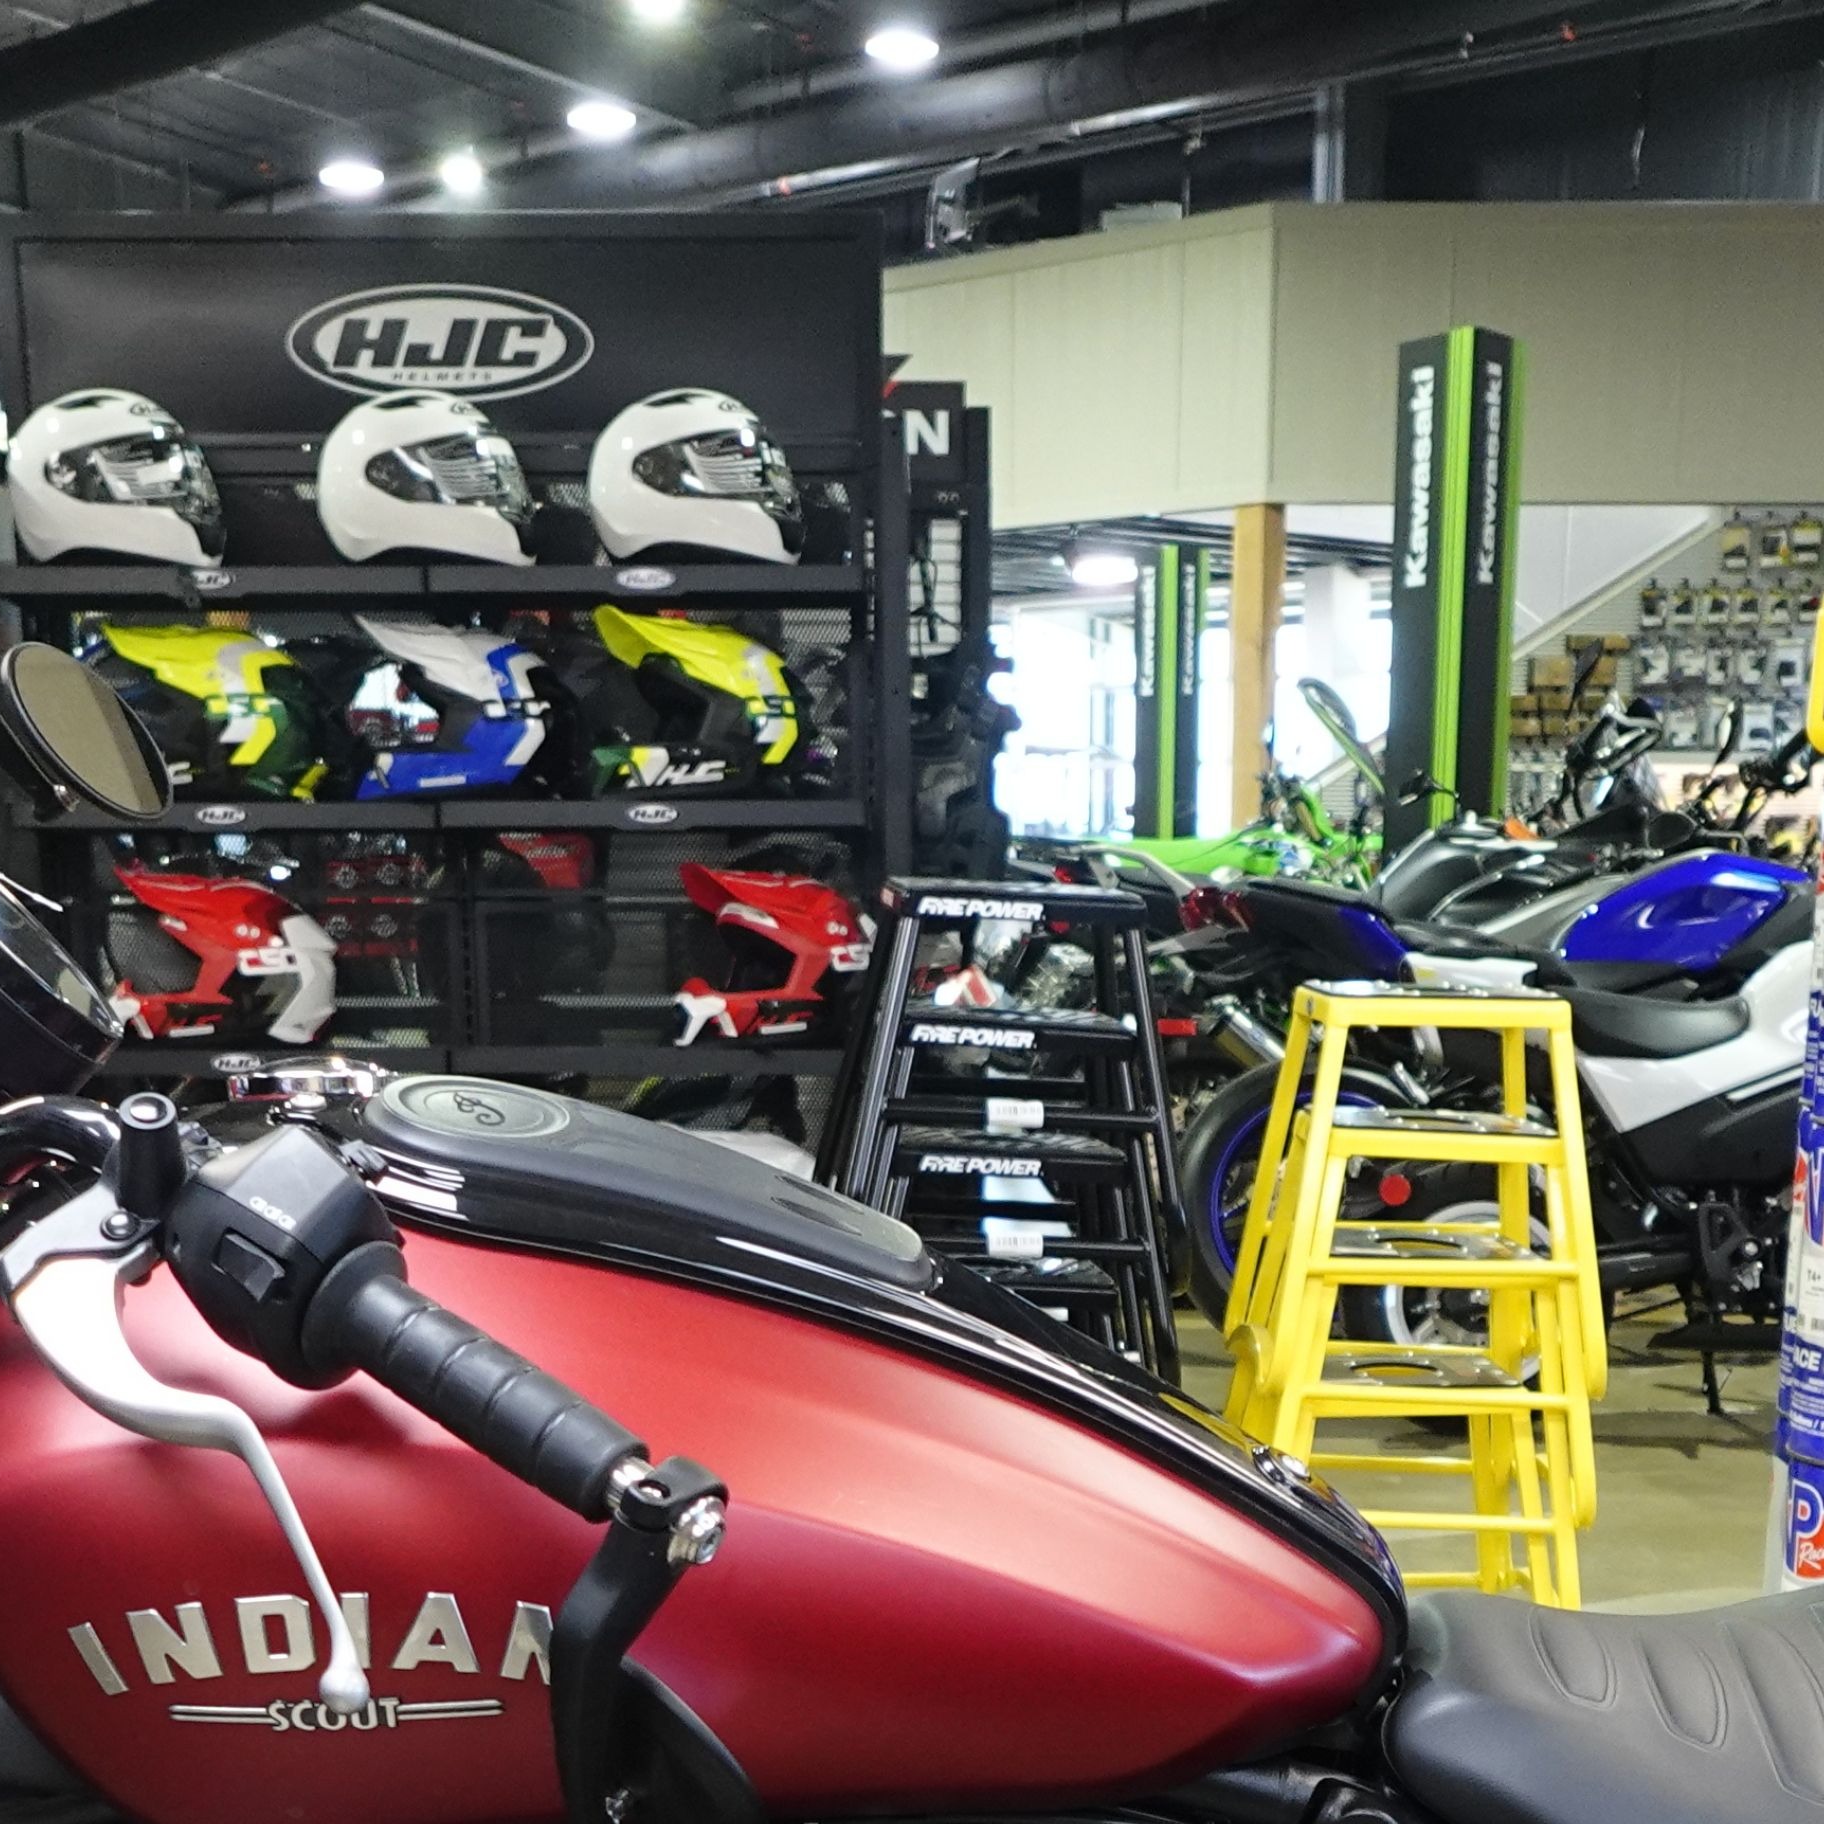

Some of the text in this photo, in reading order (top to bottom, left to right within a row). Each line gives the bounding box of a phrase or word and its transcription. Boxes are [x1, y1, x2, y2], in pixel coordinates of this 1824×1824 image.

[332, 317, 552, 368] HJC
[392, 372, 493, 382] HELMETS
[1404, 365, 1435, 589] Kawasaki
[1478, 360, 1503, 585] Kawasaki
[1137, 566, 1157, 697] Kawasaki
[965, 899, 1044, 920] POWER
[957, 1026, 1035, 1050] POWER
[966, 1158, 1042, 1176] POWER
[67, 1590, 552, 1696] INDIAN
[267, 1696, 402, 1732] SCOUT
